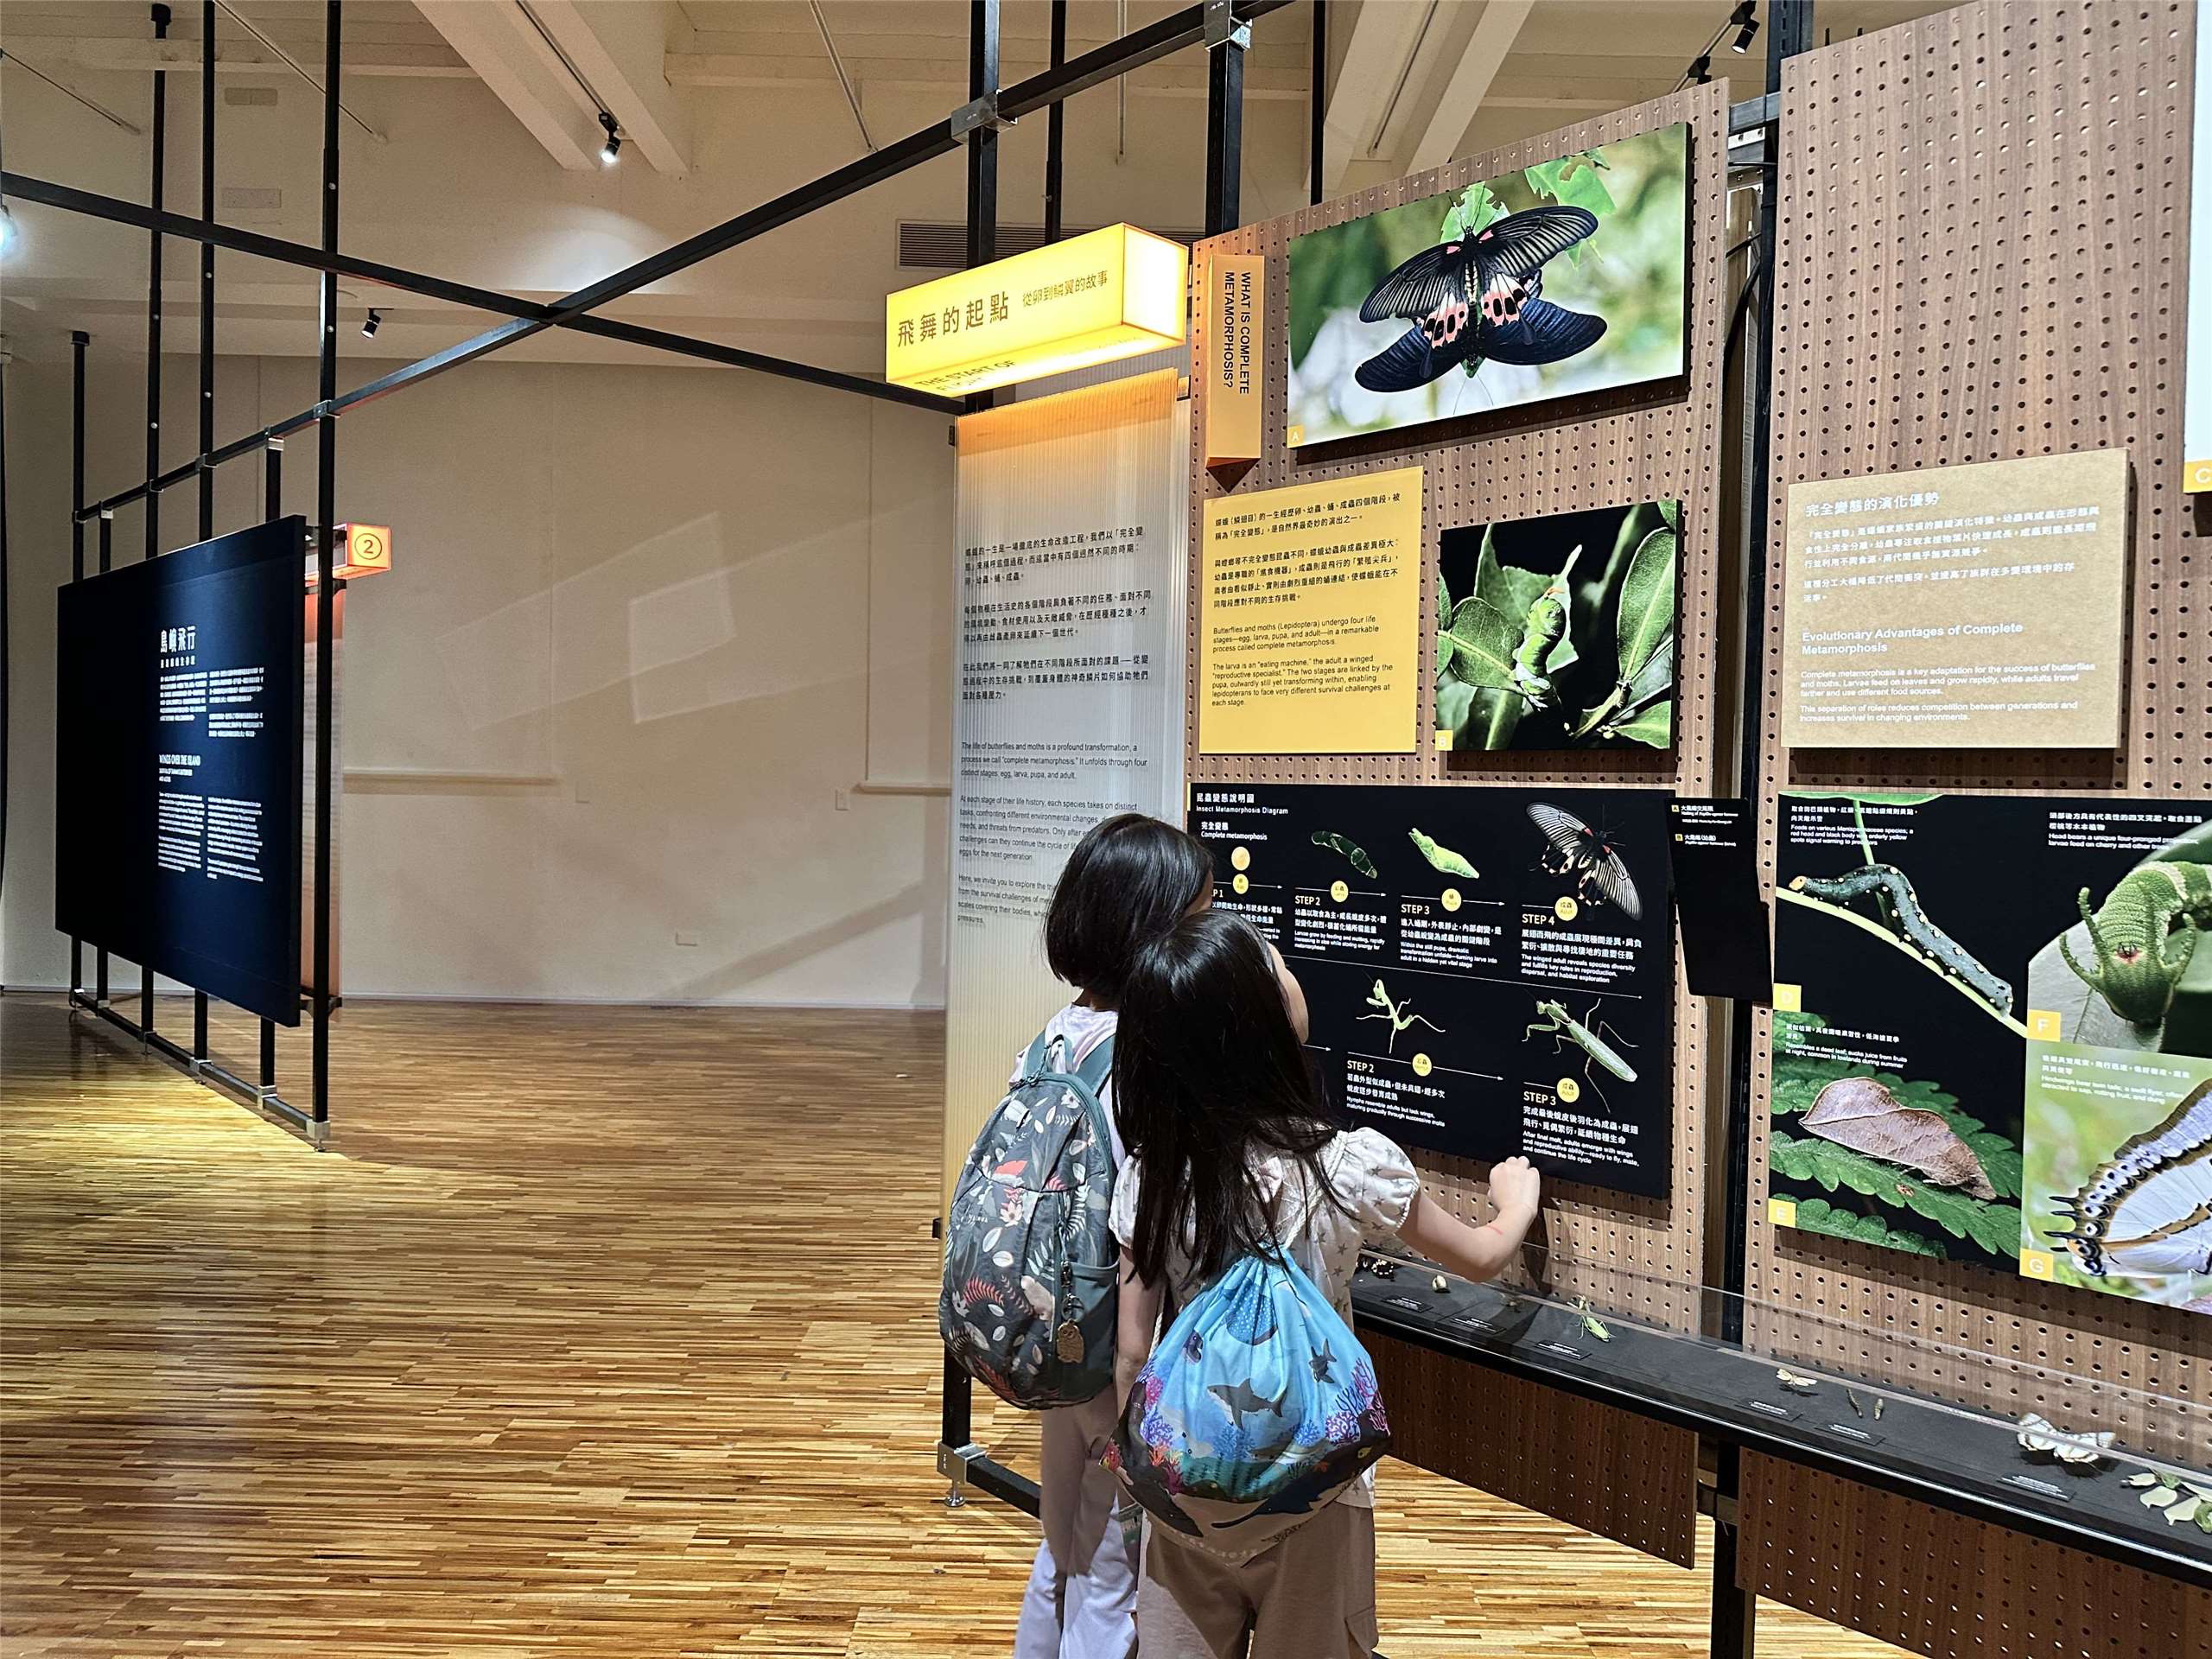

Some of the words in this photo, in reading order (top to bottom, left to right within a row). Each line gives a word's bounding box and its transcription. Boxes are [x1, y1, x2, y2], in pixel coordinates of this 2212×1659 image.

[1241, 272, 1250, 308] WHAT
[898, 291, 1008, 347] 飛舞的起點
[1241, 312, 1250, 323] IS
[1224, 271, 1234, 388] METAMORPHOSIS?
[1240, 327, 1249, 394] COMPLETE
[914, 376, 944, 386] THE
[945, 365, 995, 380] START
[994, 359, 1016, 369] OF
[1292, 431, 1300, 442] A
[2195, 467, 2212, 484] C
[1804, 492, 1939, 518] 完全變態的演化優勢
[160, 625, 196, 653] 島嶼飛行
[1802, 631, 1872, 641] Evolutionary
[1875, 627, 1943, 639] Advantages
[1948, 626, 1961, 636] of
[1963, 624, 2023, 637] Complete
[1802, 643, 1888, 656] Metamorphosis
[1439, 736, 1446, 747] B
[1226, 832, 1268, 841] metamorphosis
[1294, 895, 1315, 905] STEP
[1402, 904, 1422, 914] STEP
[1424, 906, 1430, 914] 3
[1522, 913, 1547, 925] STEP
[1548, 916, 1554, 925] 4
[2037, 1017, 2050, 1033] F
[1347, 1060, 1367, 1071] STEP
[1369, 1065, 1375, 1073] 2
[1523, 1091, 1548, 1103] STEP
[1550, 1096, 1556, 1106] 3
[1777, 1206, 1785, 1220] E
[2029, 1258, 2044, 1273] G
